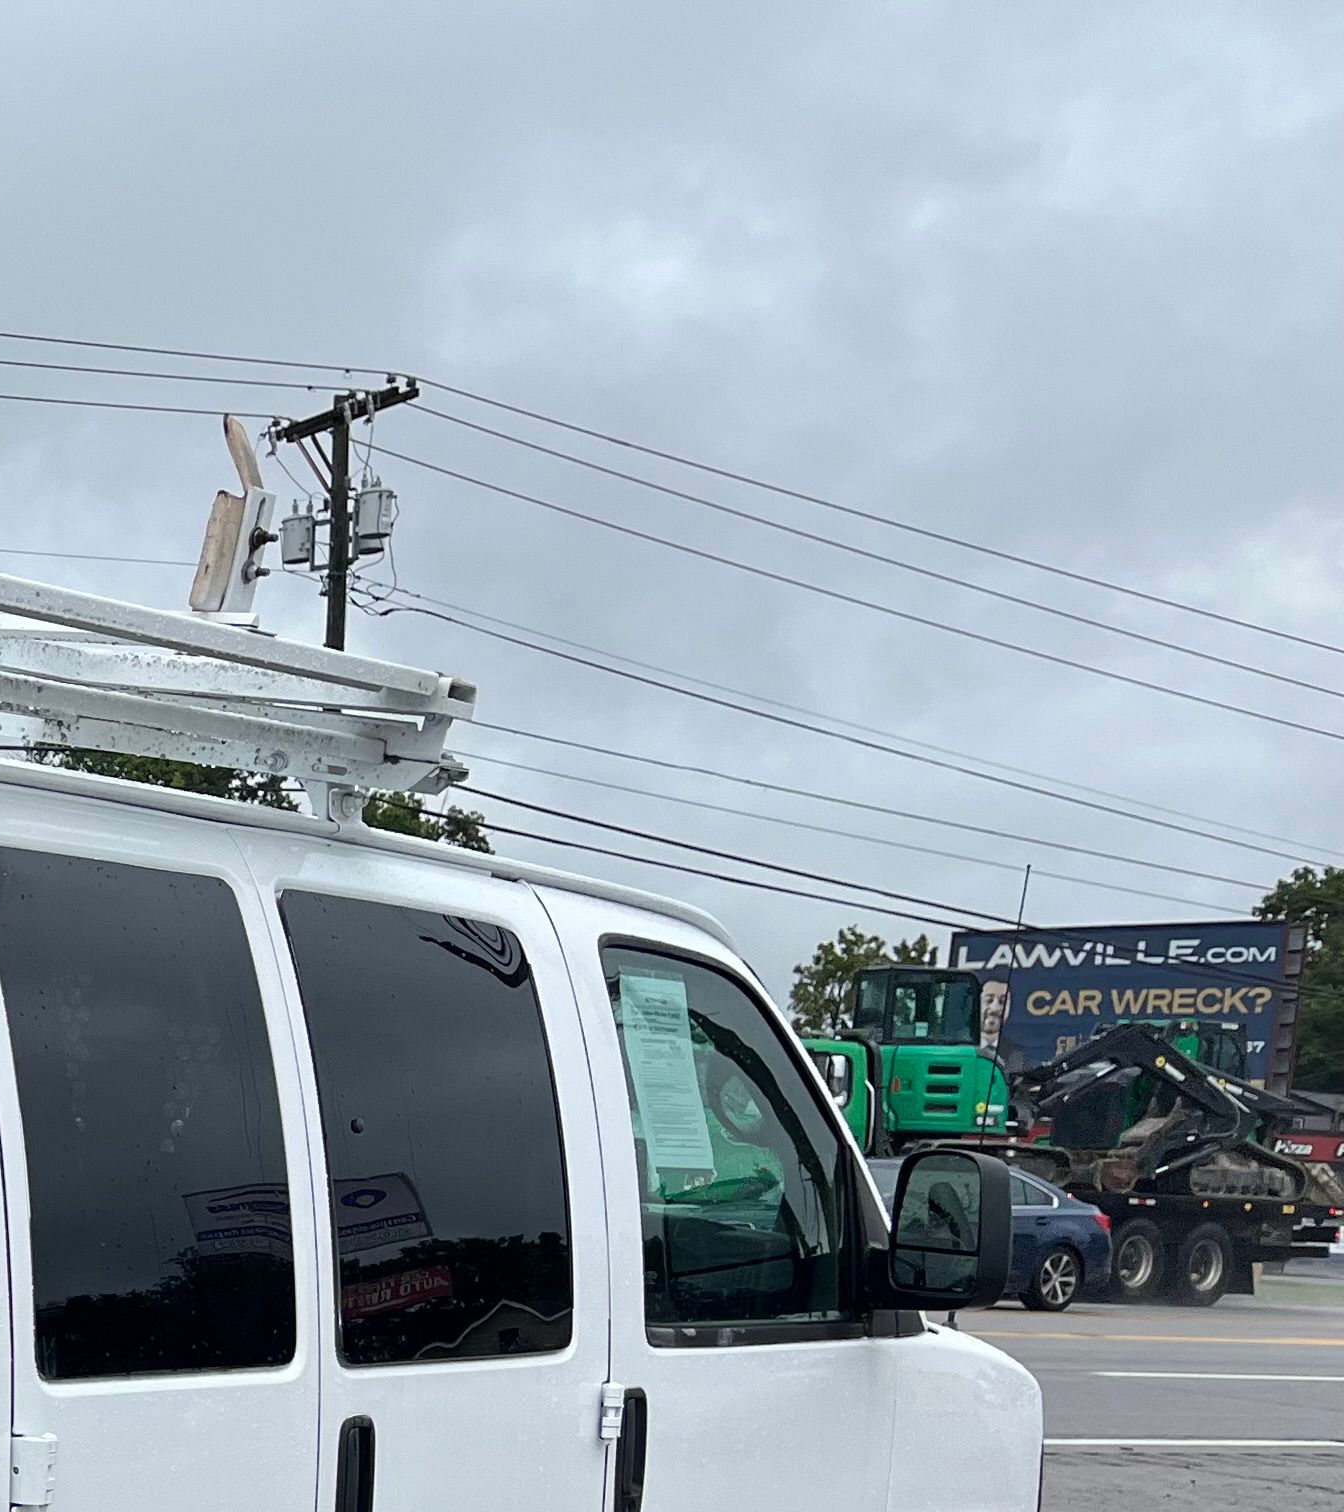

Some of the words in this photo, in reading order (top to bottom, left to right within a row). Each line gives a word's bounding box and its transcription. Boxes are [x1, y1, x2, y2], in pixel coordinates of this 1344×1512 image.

[956, 938, 1277, 970] LAWVILLE.COM
[1026, 989, 1103, 1016] CAR
[1110, 987, 1273, 1016] WRECK?
